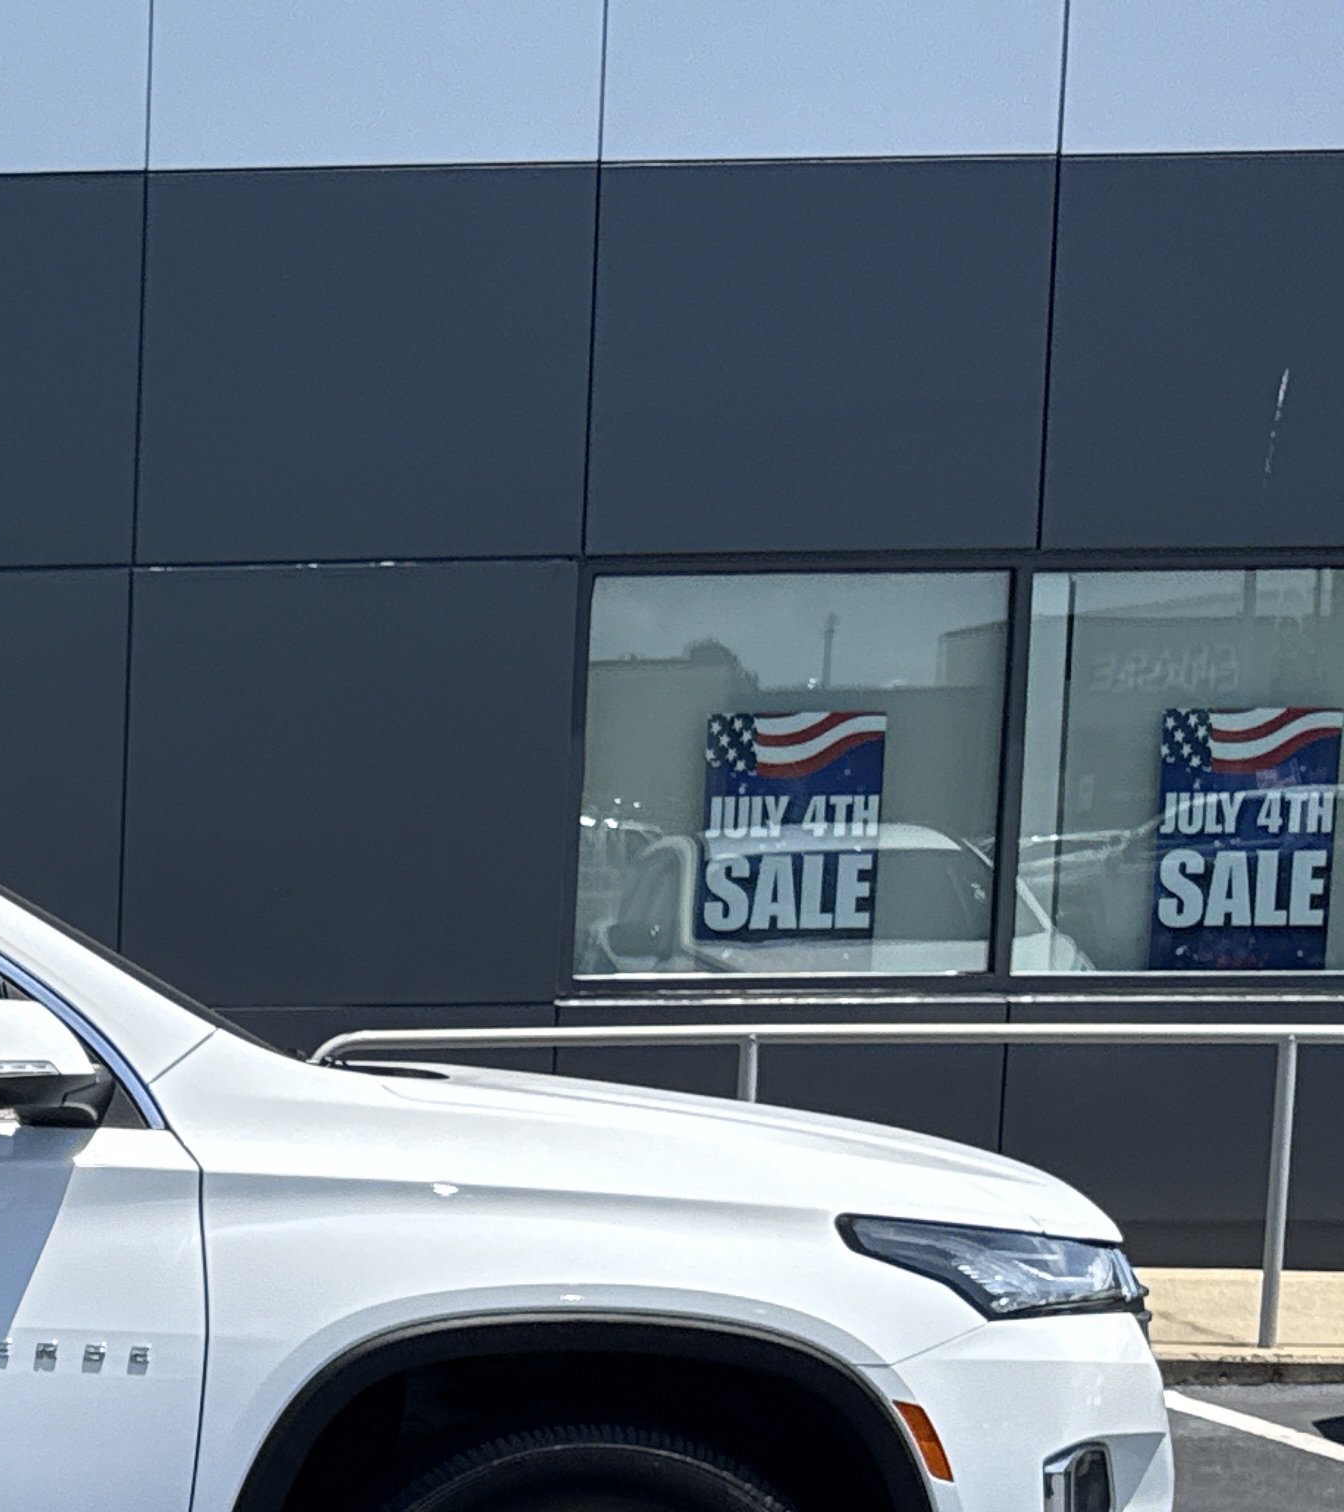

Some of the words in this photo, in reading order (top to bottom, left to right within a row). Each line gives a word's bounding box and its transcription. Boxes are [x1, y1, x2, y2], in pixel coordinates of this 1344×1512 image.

[705, 795, 790, 838] JULY
[801, 795, 879, 838] 4TH
[1159, 791, 1246, 835] JULY
[1257, 791, 1335, 834] 4TH
[704, 853, 873, 931] SALE
[1158, 849, 1327, 928] SALE
